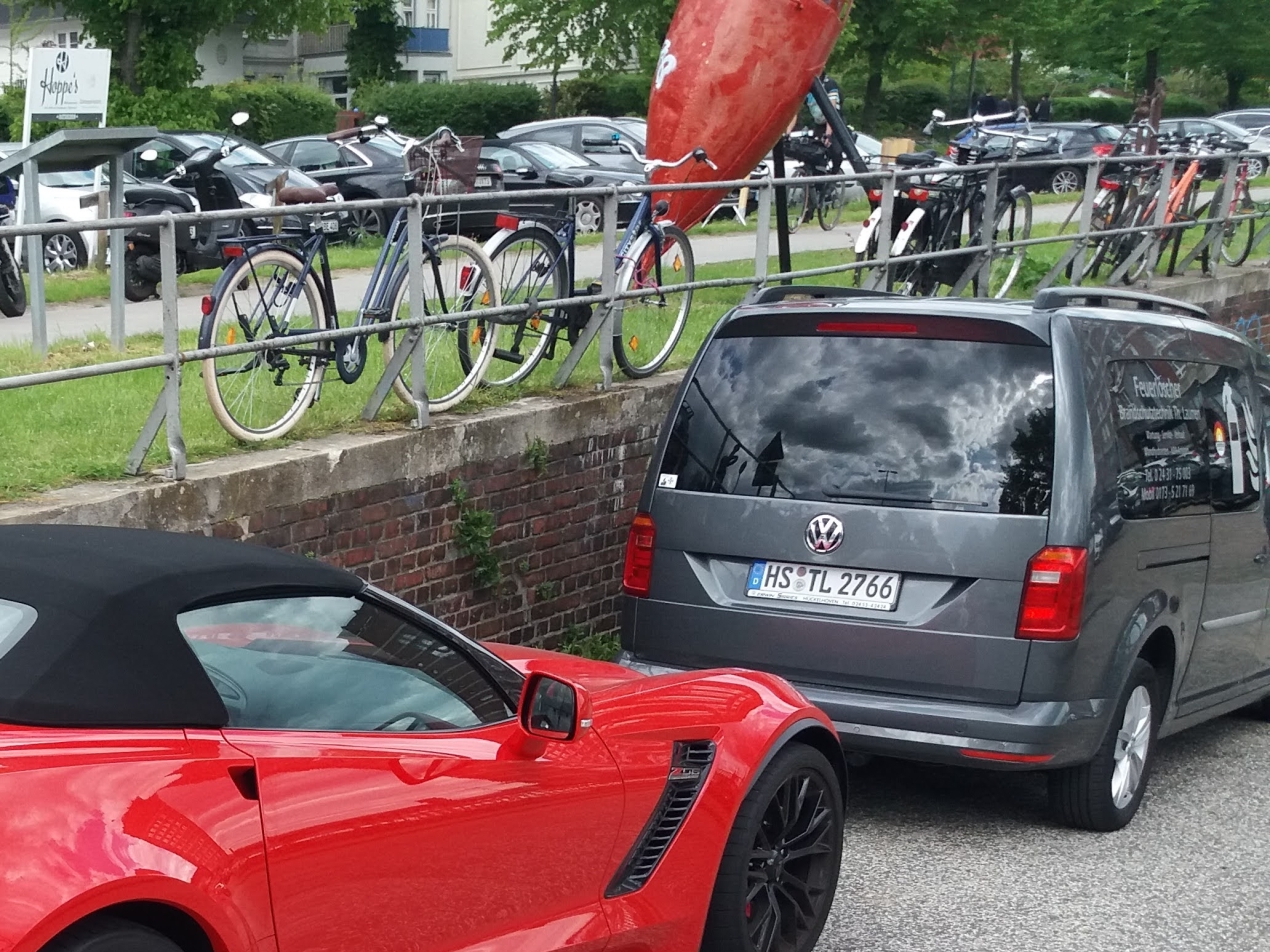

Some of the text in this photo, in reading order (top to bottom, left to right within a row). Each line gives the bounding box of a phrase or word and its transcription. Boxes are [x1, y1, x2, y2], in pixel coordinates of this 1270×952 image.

[40, 67, 78, 106] Hoppe's
[764, 565, 894, 599] HS TL 2766
